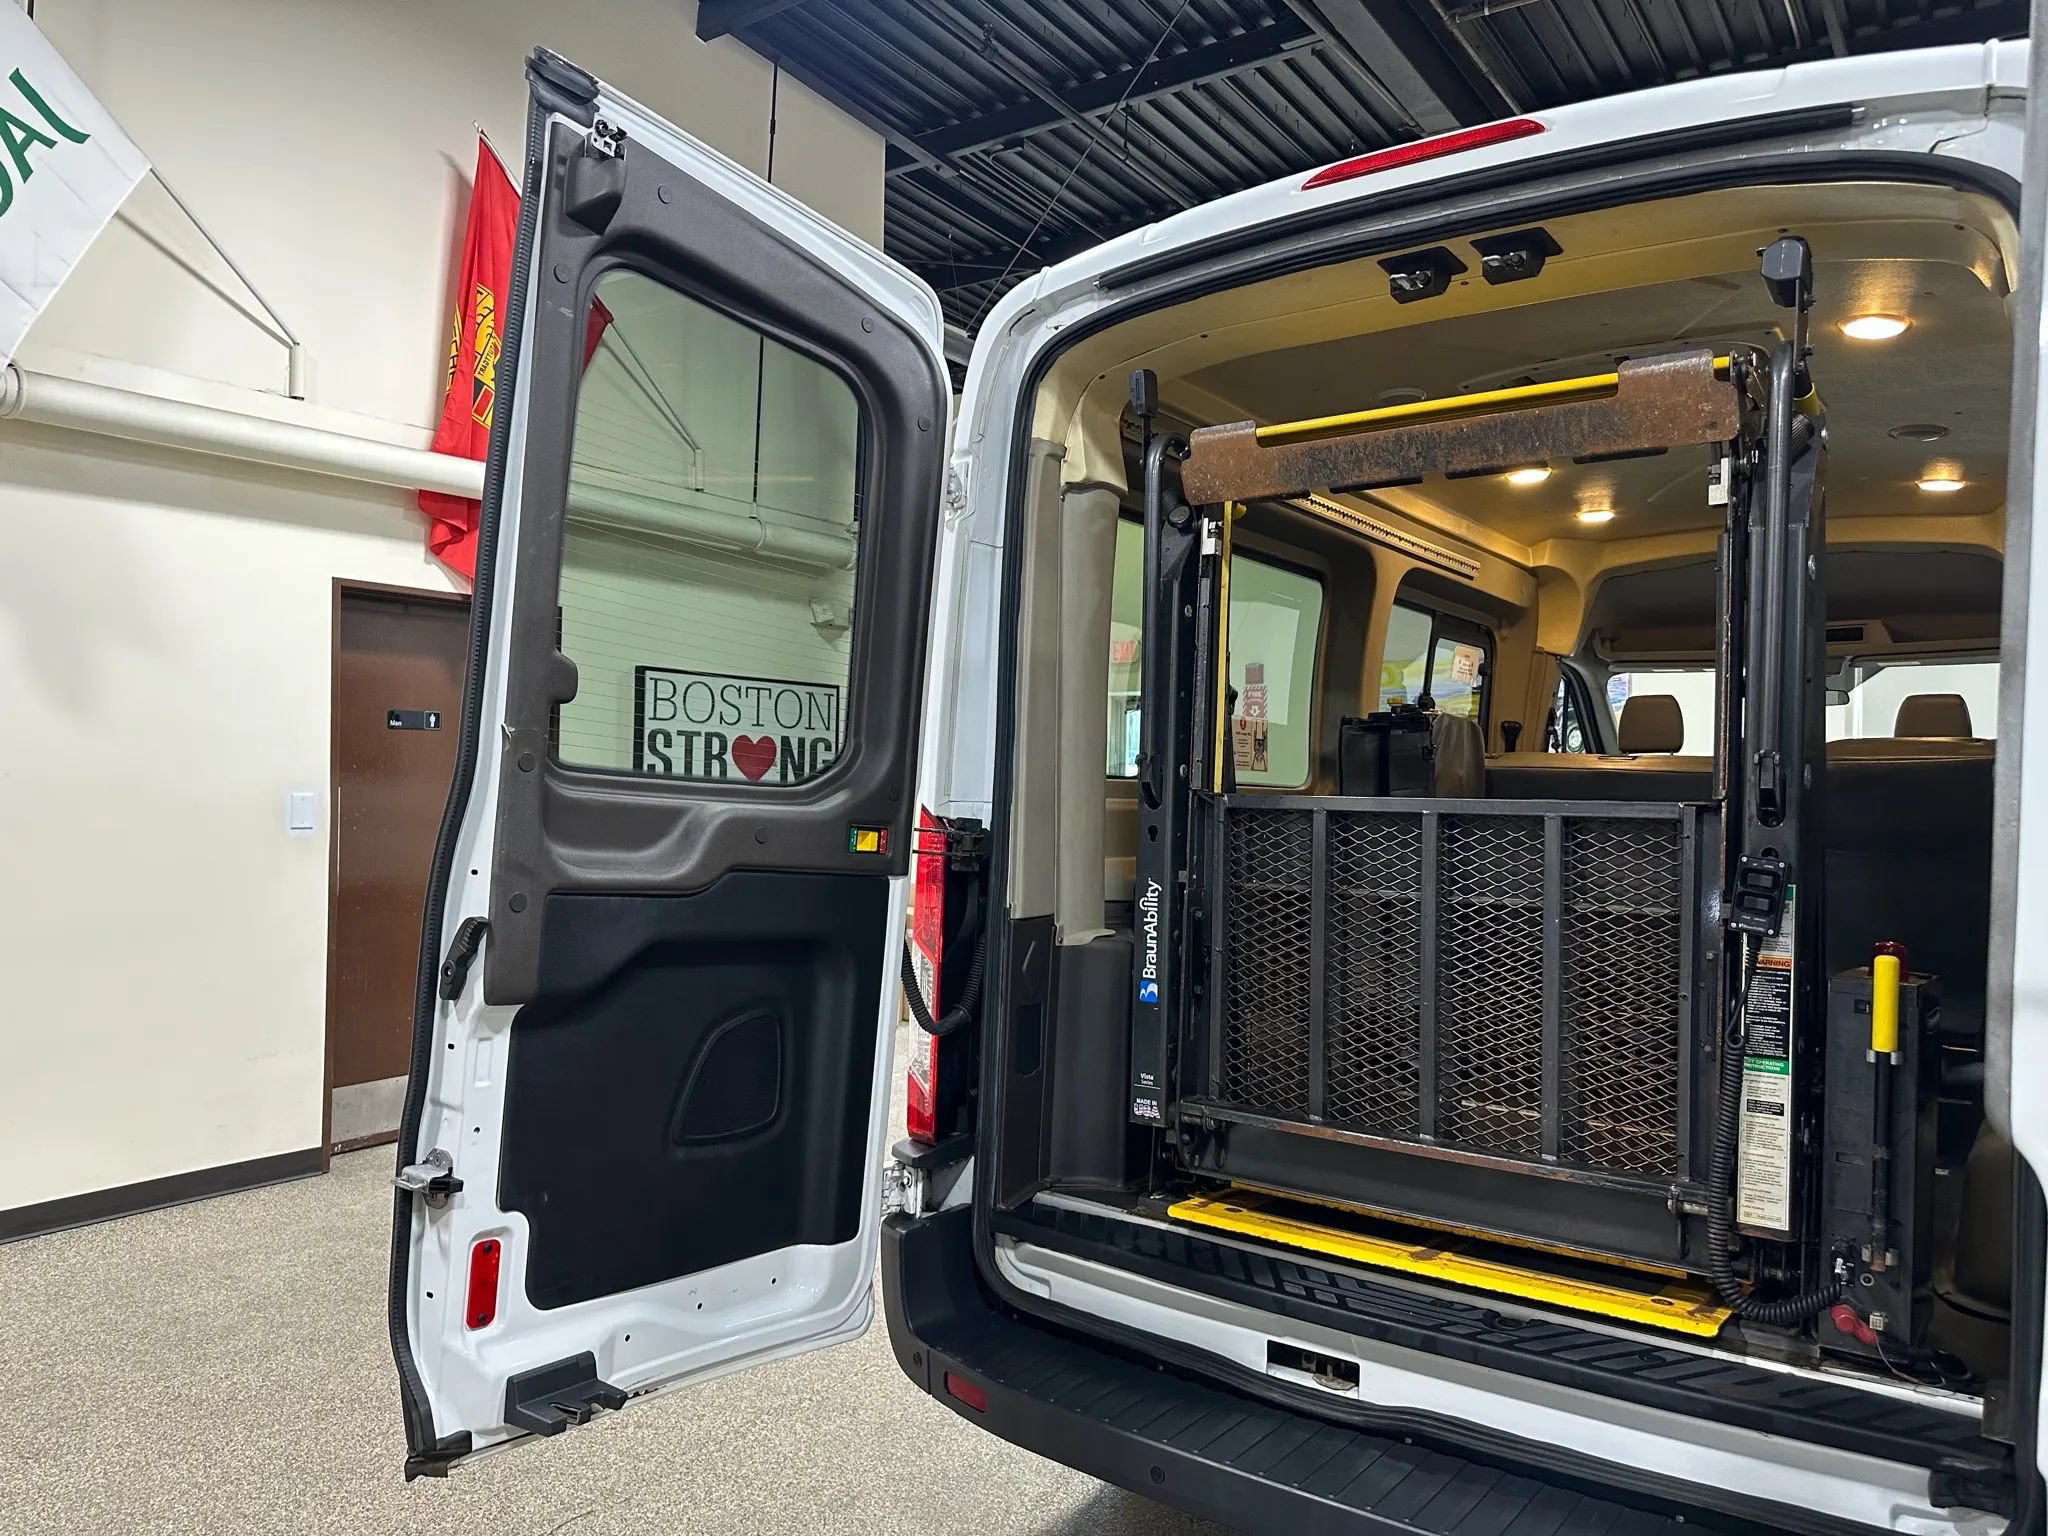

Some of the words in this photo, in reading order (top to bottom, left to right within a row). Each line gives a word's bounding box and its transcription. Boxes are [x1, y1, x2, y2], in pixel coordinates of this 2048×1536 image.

[1112, 640, 1136, 662] EXIT
[1247, 690, 1263, 698] FIRE
[648, 676, 835, 732] BOSTON
[389, 719, 402, 727] Men
[1139, 879, 1162, 979] BraunAbility
[1140, 1072, 1154, 1080] Vista
[1136, 1097, 1151, 1106] MADE
[1133, 1103, 1161, 1119] USA
